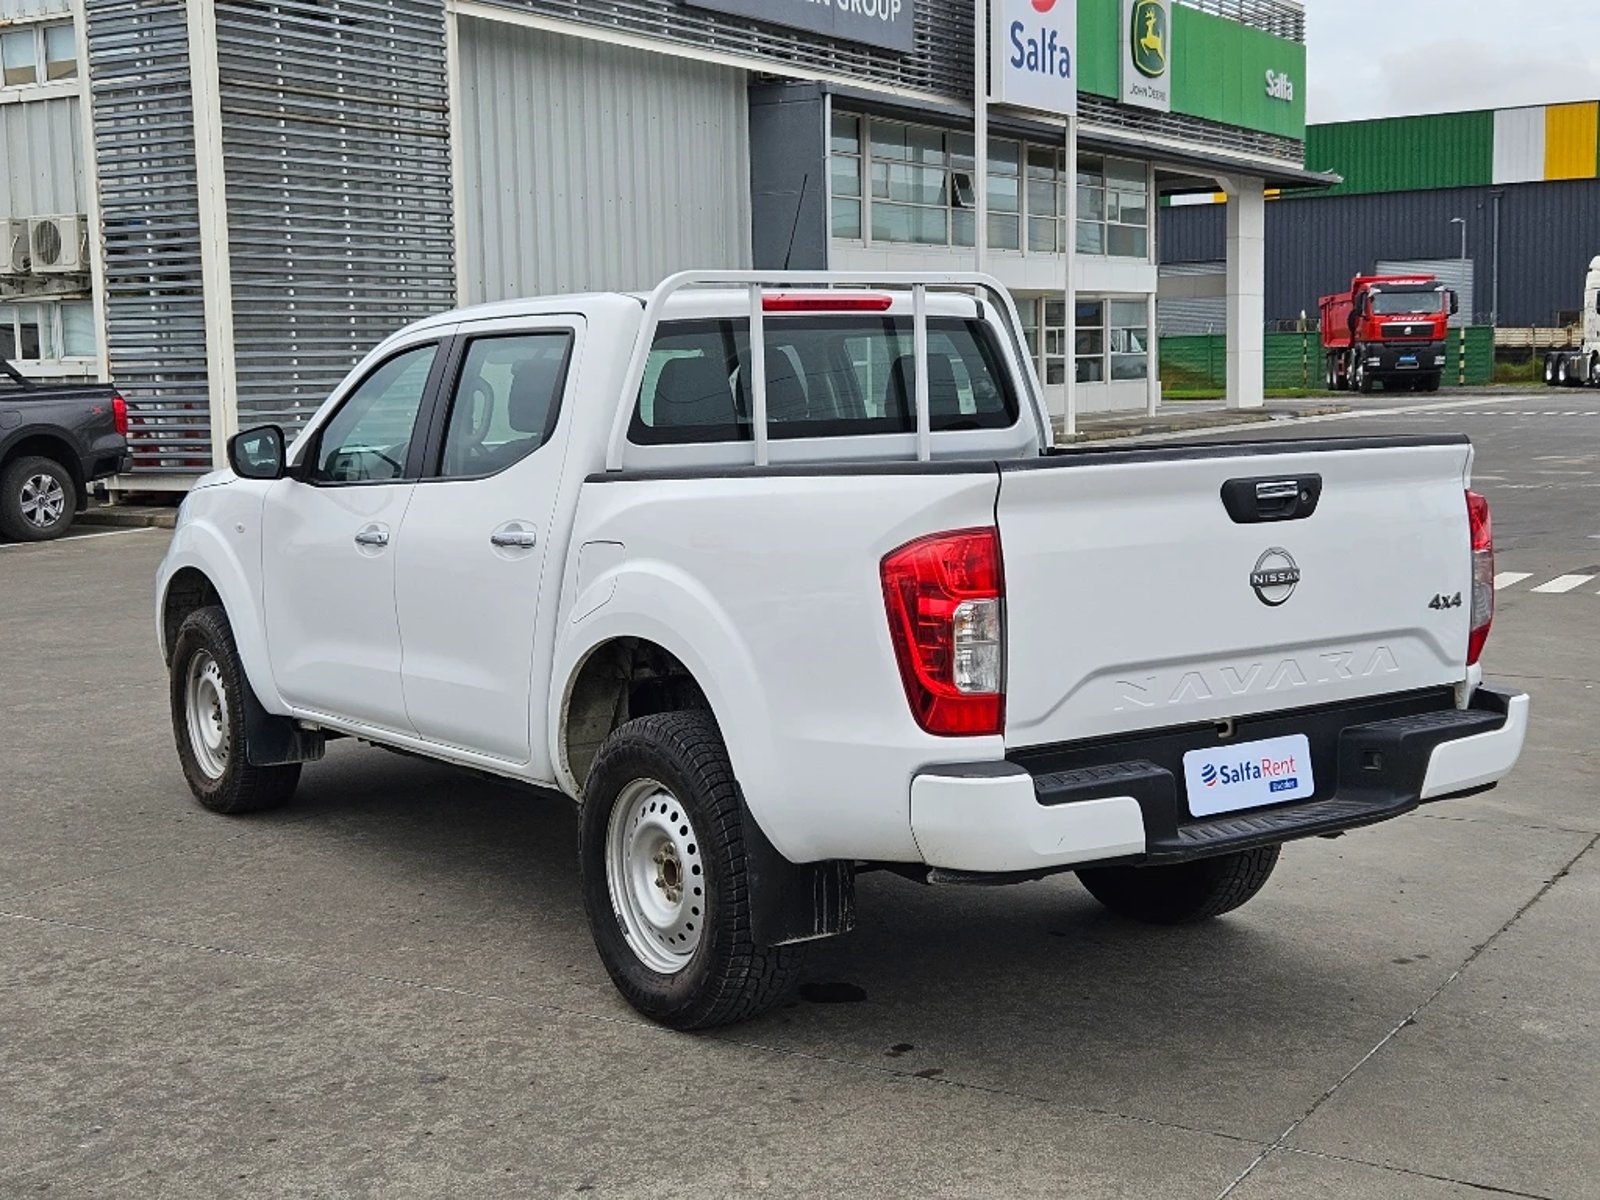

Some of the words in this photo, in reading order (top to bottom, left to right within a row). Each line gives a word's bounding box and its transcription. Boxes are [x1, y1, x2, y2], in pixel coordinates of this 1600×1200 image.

[1010, 20, 1071, 79] Salfa
[1129, 83, 1148, 98] JOHN
[1265, 69, 1293, 101] Salfa
[1253, 571, 1300, 584] NISSAN
[1114, 646, 1400, 711] NAVARA
[1219, 755, 1297, 785] SalfaRent
